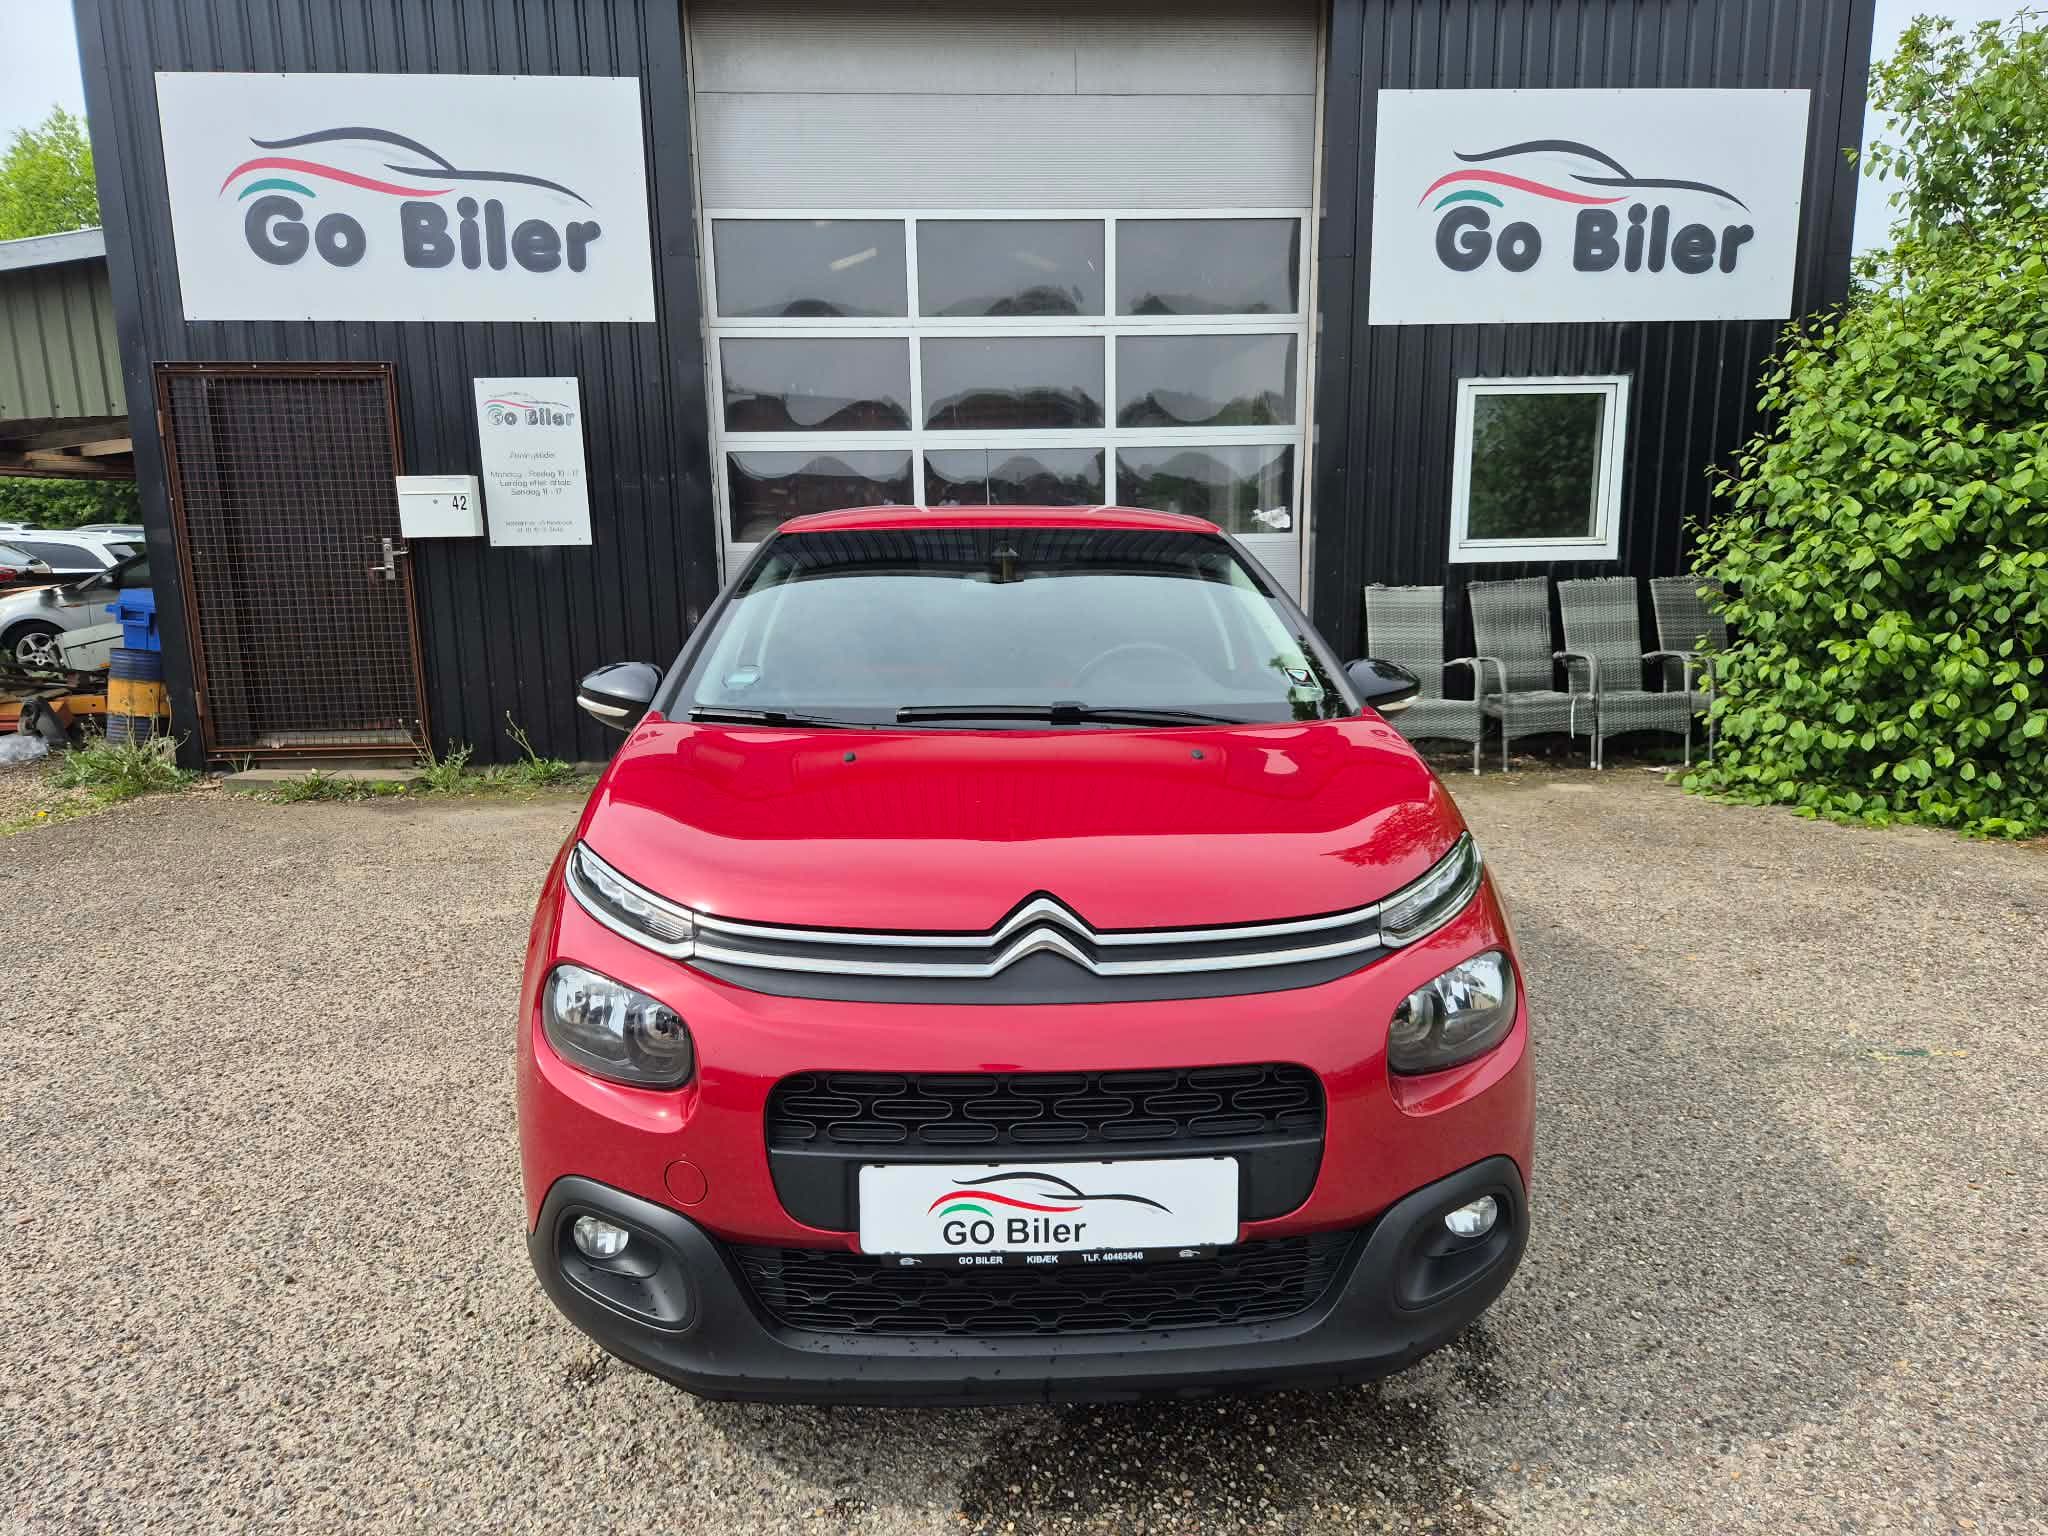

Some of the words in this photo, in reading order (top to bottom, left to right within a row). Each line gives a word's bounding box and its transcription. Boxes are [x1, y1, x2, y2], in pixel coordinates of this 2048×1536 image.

[244, 195, 367, 267] Go
[400, 197, 601, 273] Biler
[1435, 205, 1542, 273] Go
[1573, 203, 1755, 275] Biler
[488, 408, 518, 426] Go
[525, 407, 575, 426] Biler
[452, 495, 468, 511] 42
[942, 1220, 995, 1246] GO
[1006, 1218, 1087, 1245] Biler
[958, 1256, 973, 1265] GO
[975, 1255, 1003, 1265] BILER
[1026, 1255, 1059, 1265] KIBÆK
